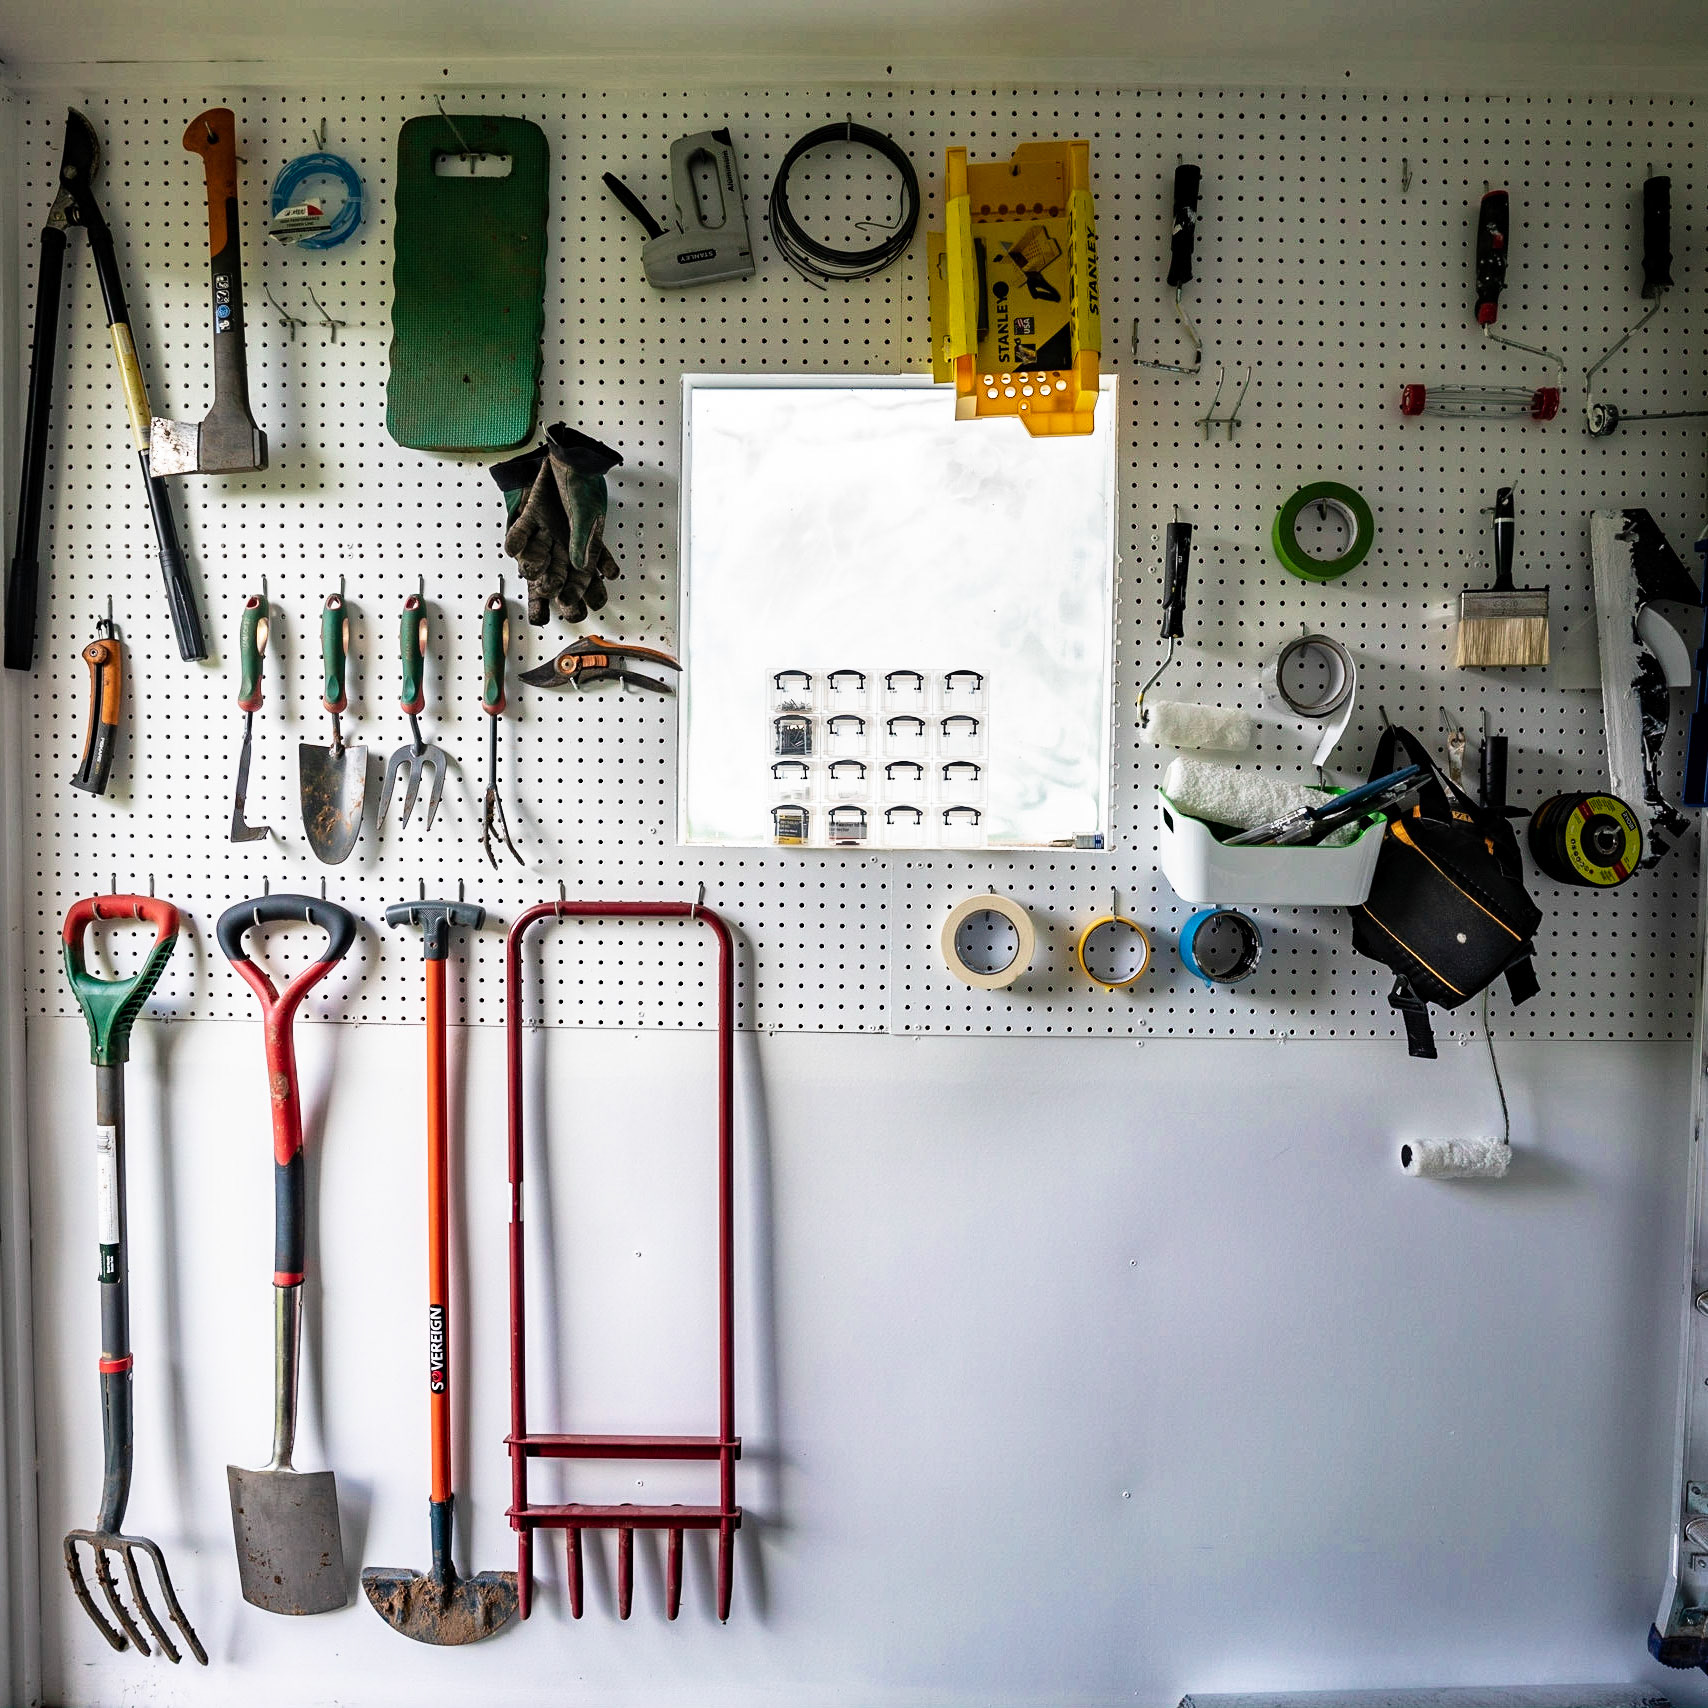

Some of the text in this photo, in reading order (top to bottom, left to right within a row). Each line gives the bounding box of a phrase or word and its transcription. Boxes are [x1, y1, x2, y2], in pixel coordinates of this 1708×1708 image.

[679, 250, 716, 262] STANLEY
[1087, 225, 1099, 315] STANLEY
[997, 297, 1010, 363] STANLEY
[1023, 318, 1031, 334] USA
[429, 1306, 444, 1391] SOVEREIGN
